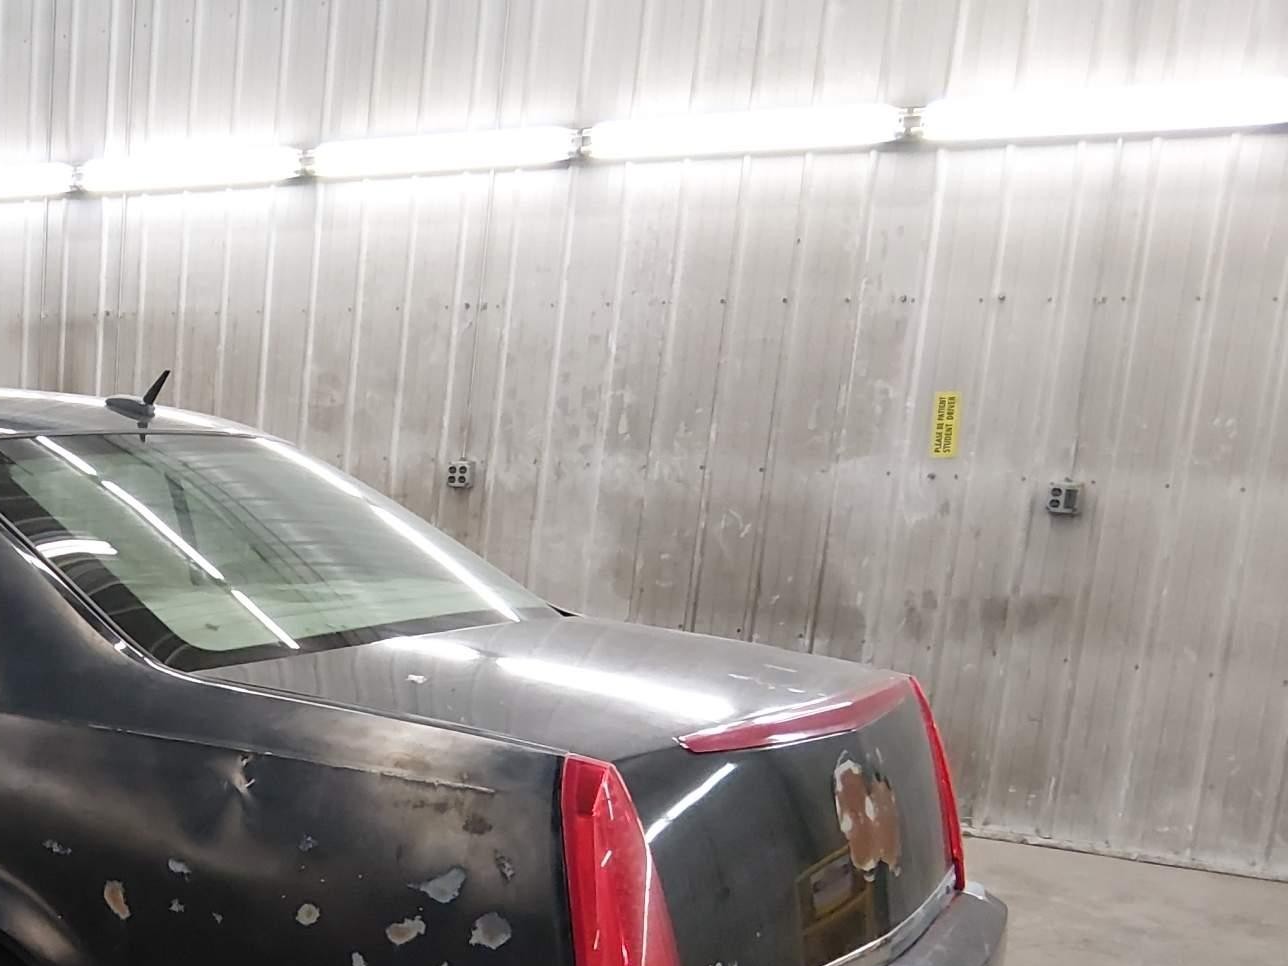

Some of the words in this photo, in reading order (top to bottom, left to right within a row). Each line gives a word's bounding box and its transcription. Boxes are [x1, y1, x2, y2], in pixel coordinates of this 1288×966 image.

[937, 397, 947, 421] PATIENT
[946, 396, 956, 420] DRIVER
[934, 432, 943, 453] PLEASE
[942, 424, 953, 453] STUDENT
